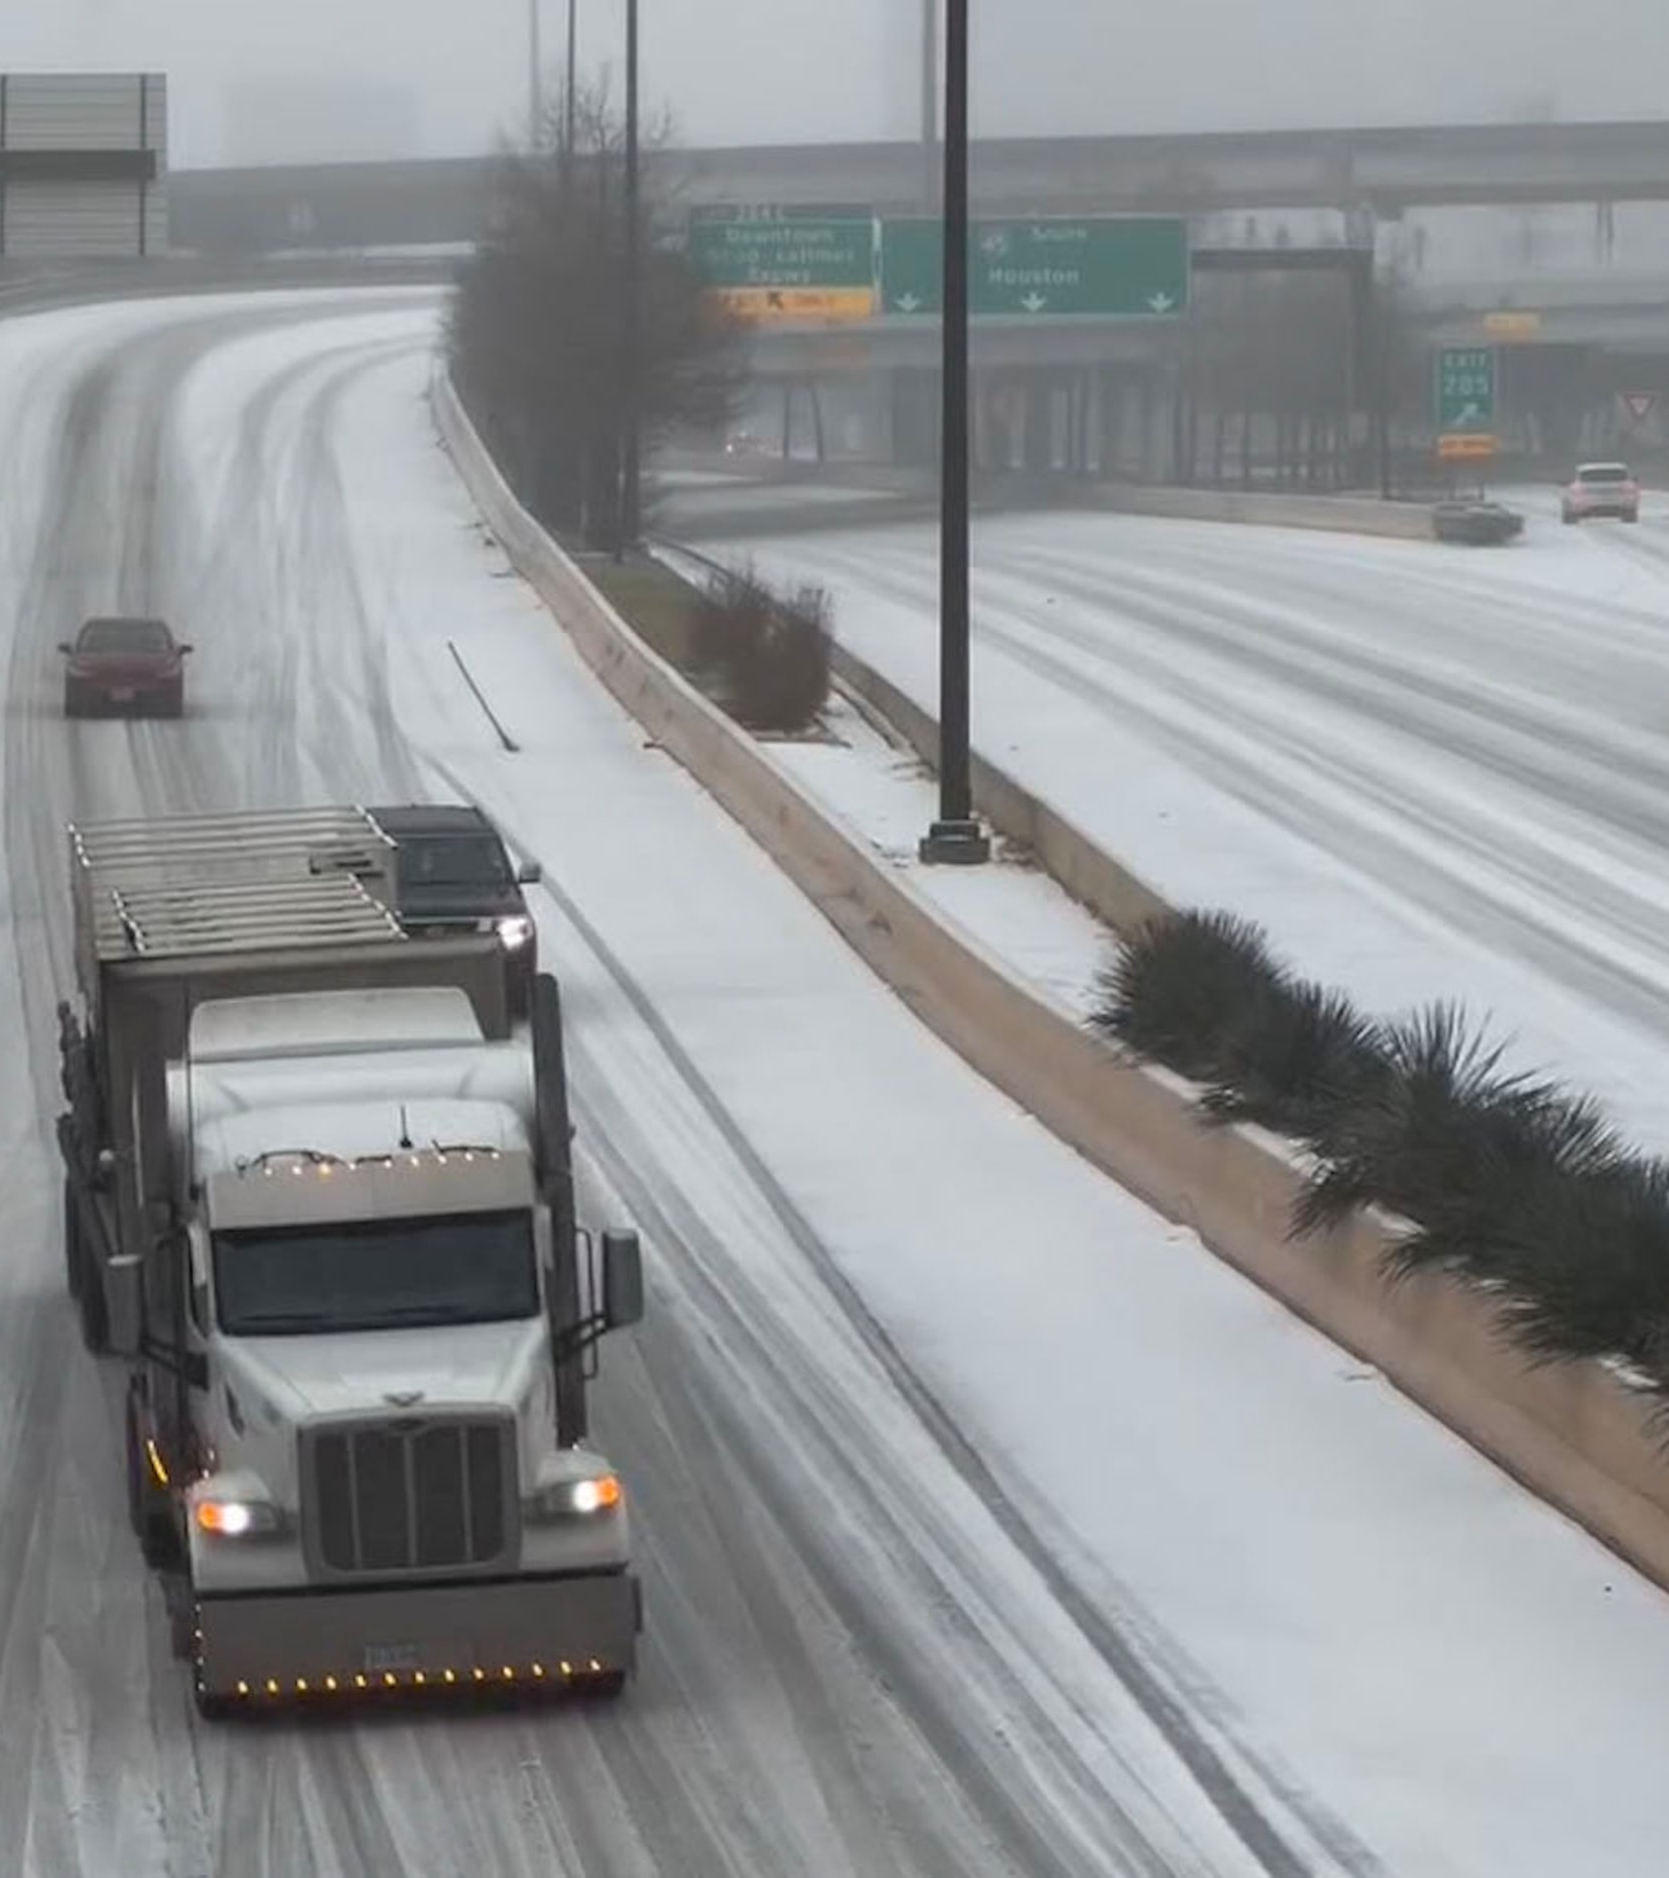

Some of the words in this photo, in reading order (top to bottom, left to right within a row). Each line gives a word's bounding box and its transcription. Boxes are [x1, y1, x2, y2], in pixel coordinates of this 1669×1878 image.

[725, 228, 834, 244] Downtown
[988, 266, 1080, 285] Houston
[1443, 352, 1487, 368] EXIT
